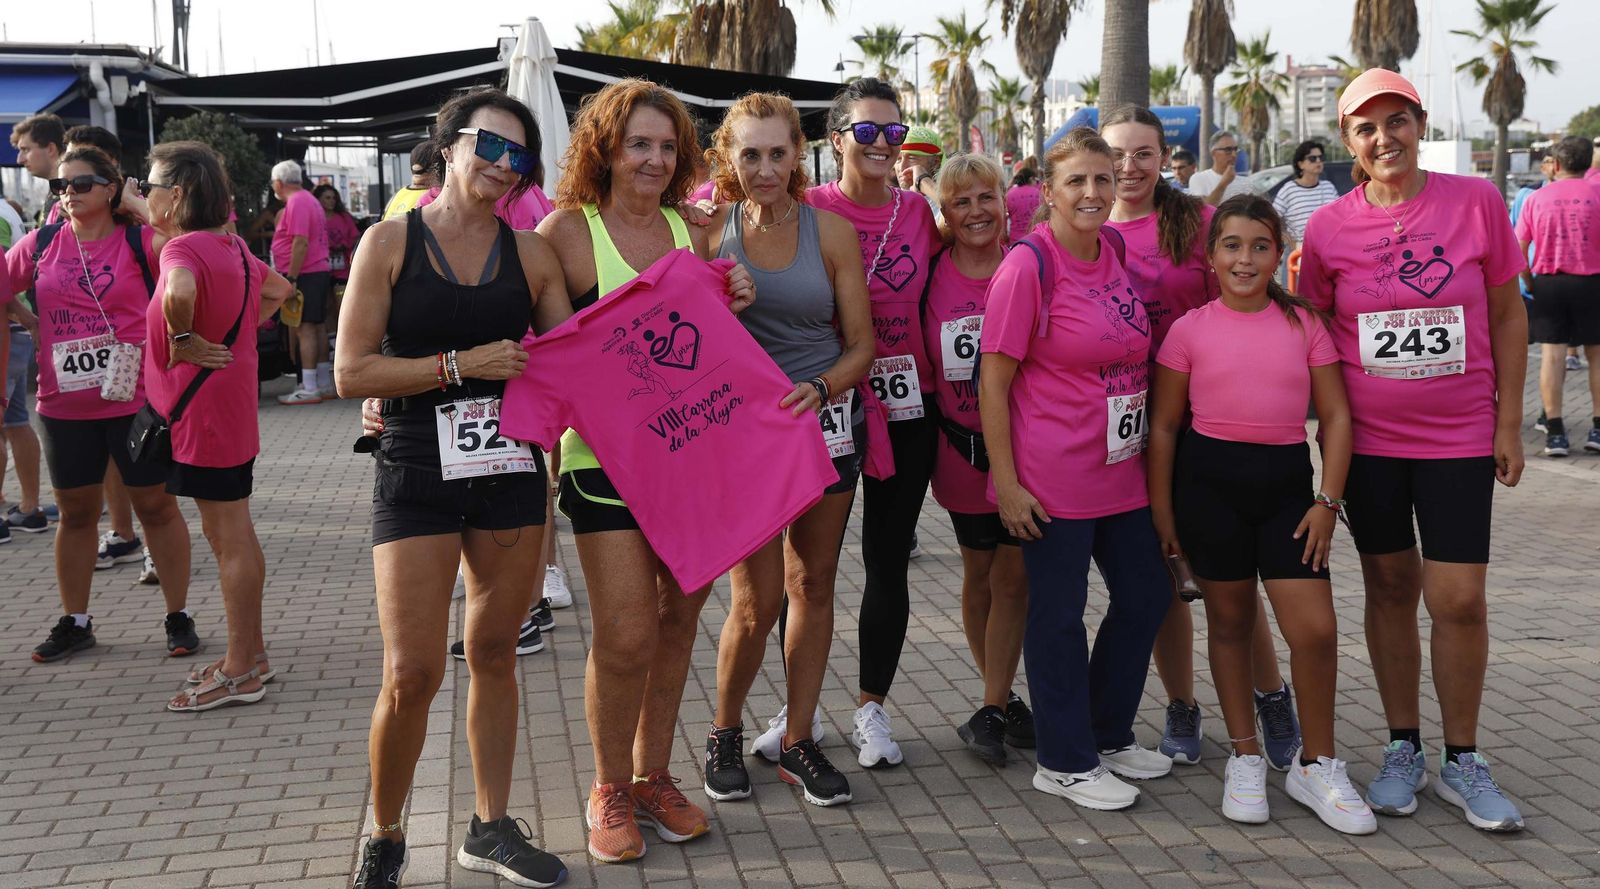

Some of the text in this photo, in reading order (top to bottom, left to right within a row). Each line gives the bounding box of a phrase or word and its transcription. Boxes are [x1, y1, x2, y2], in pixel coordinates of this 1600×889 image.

[48, 309, 71, 325] VIII
[962, 323, 981, 333] POR
[1384, 315, 1460, 329] POR LA MUJER
[954, 333, 981, 359] 6
[1374, 327, 1452, 359] 243
[63, 348, 110, 375] 408
[886, 362, 913, 374] MUJER
[869, 373, 909, 402] 86
[463, 410, 485, 420] POR
[648, 382, 732, 438] VIII Carrera
[819, 406, 845, 434] 47
[457, 419, 521, 452] 52
[669, 395, 744, 453] de la Mujer
